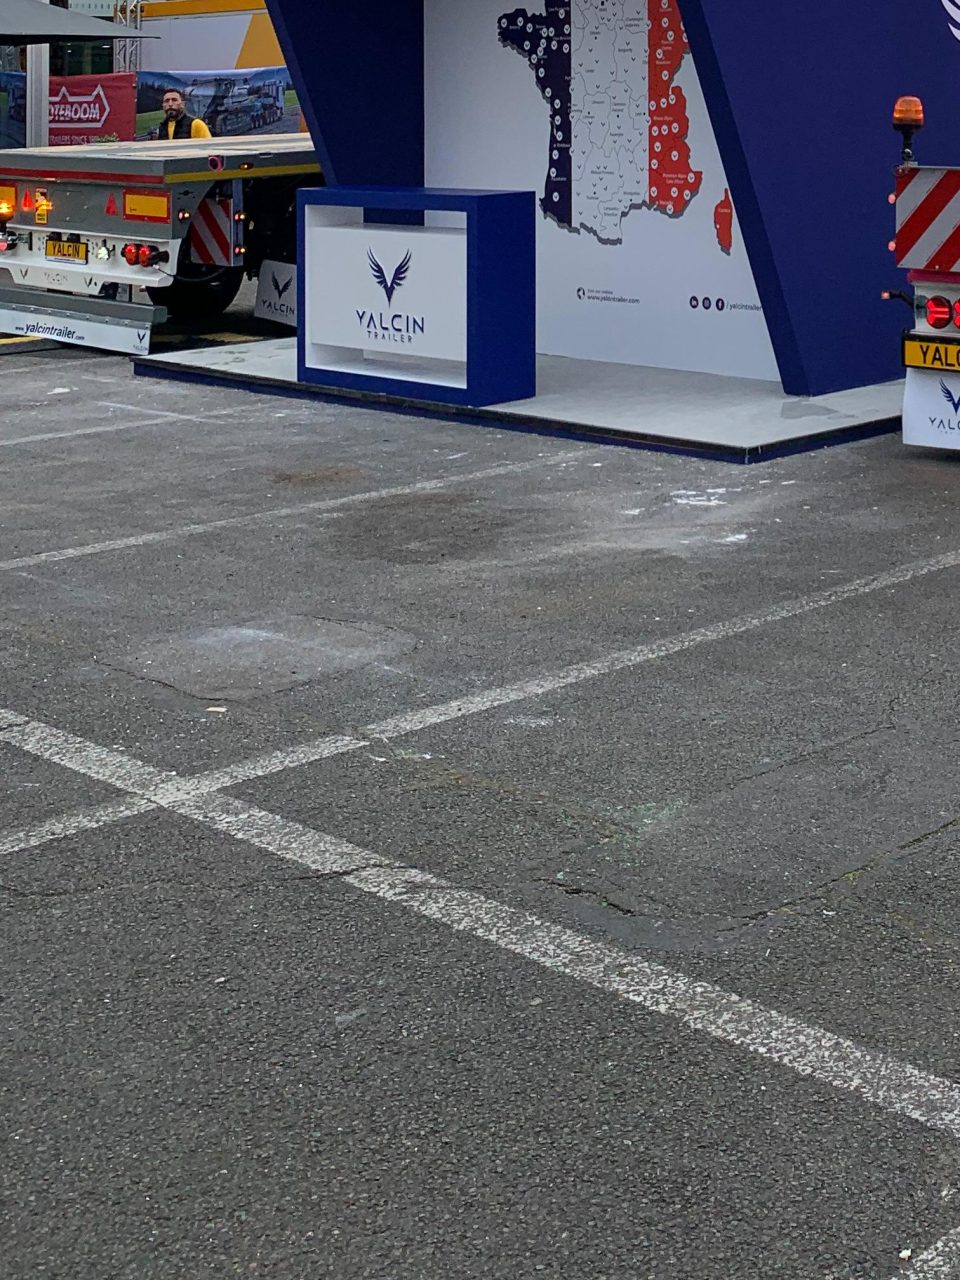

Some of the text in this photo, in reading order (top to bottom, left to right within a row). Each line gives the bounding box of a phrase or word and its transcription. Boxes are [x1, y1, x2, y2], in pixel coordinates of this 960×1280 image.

[52, 242, 80, 258] YALCIN
[261, 299, 295, 316] YALCIN
[356, 309, 425, 334] YALCIN
[367, 330, 413, 343] TRAILER
